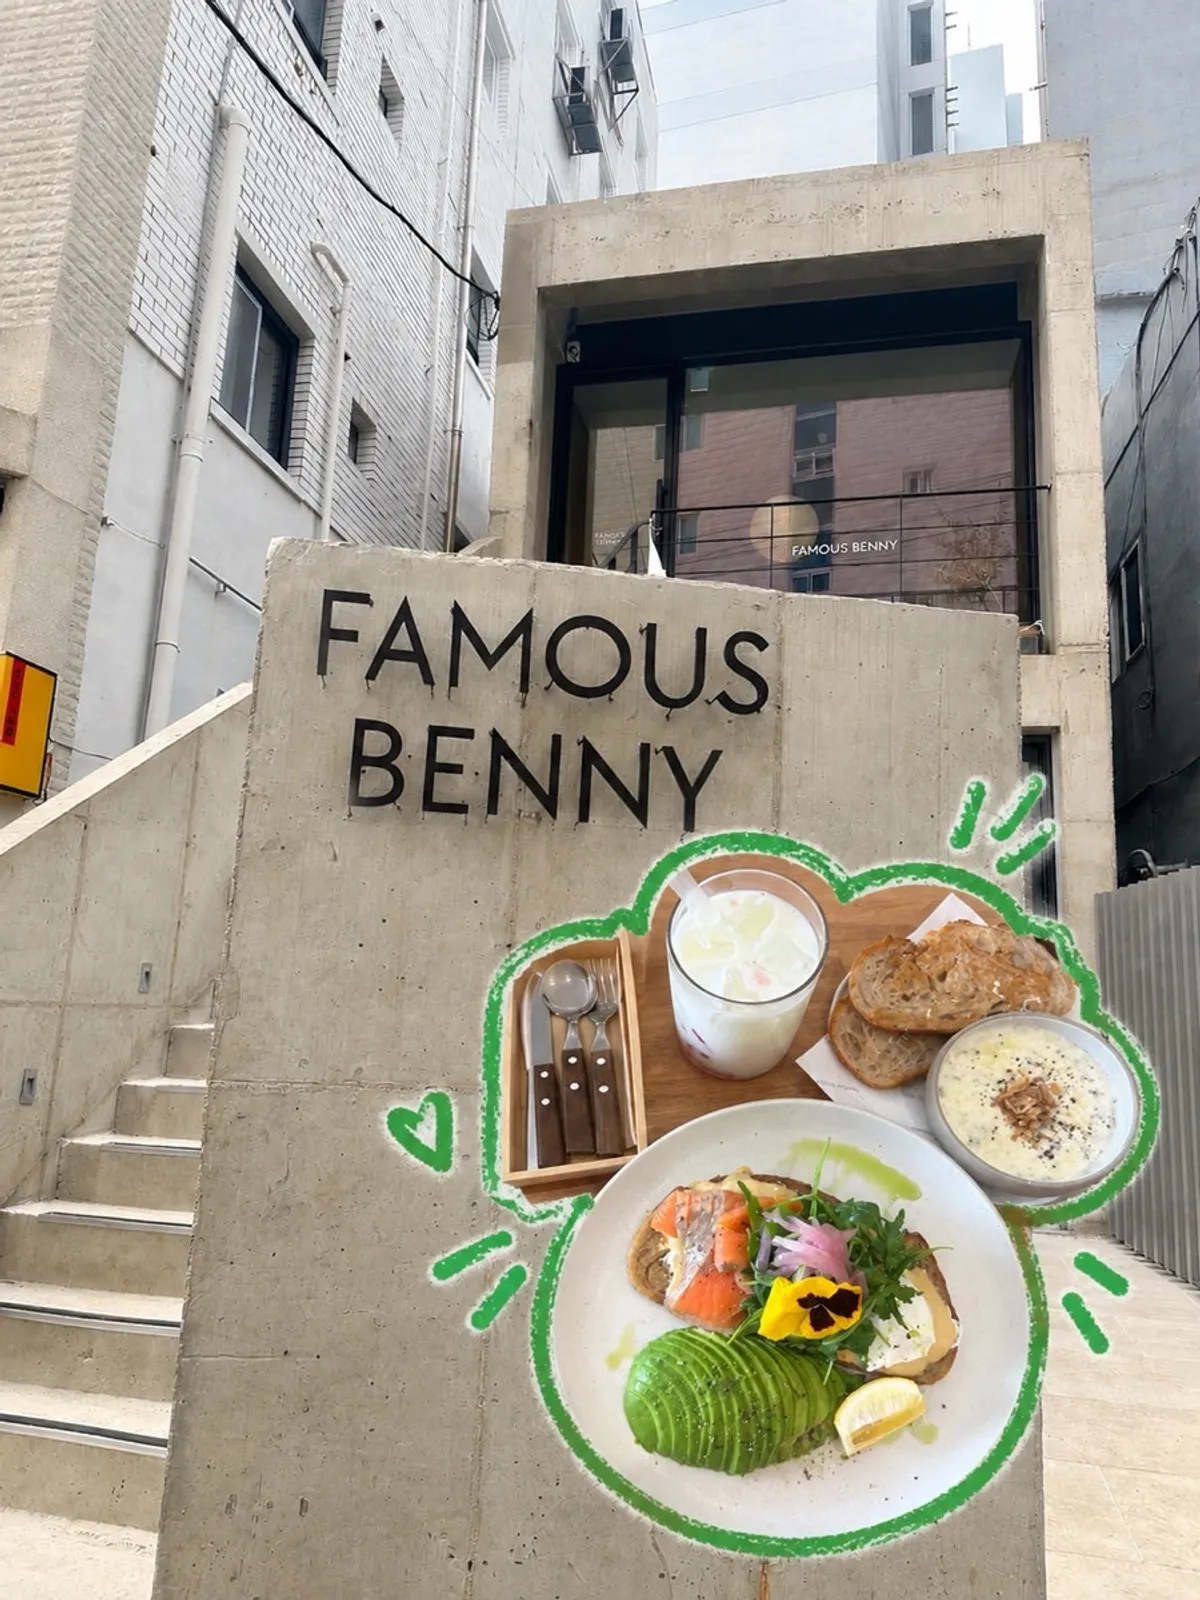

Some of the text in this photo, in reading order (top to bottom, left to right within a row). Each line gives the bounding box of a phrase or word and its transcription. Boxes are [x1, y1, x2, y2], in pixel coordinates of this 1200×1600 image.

[792, 540, 898, 556] FAMOUS BENNY
[317, 588, 770, 715] FAMOUS
[348, 717, 723, 832] BENNY
